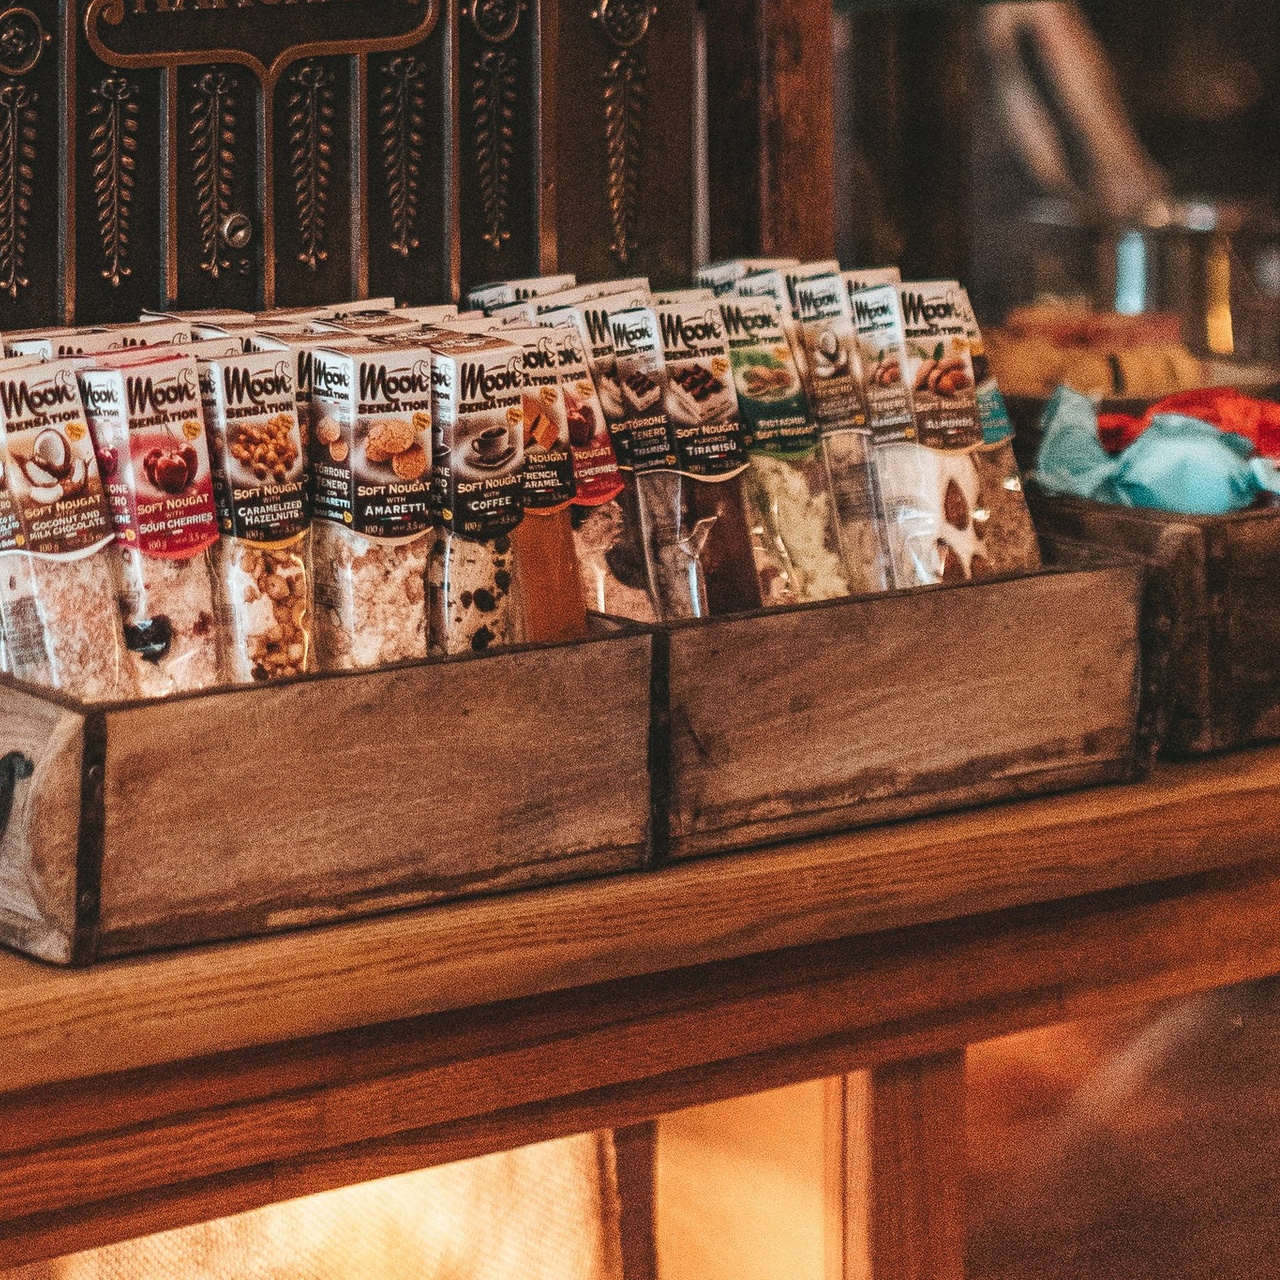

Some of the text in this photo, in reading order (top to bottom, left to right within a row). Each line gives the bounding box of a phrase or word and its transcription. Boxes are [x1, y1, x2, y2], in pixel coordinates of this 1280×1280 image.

[612, 319, 653, 348] Moon
[659, 311, 722, 348] Moon
[664, 346, 725, 360] SENSATION
[313, 357, 350, 390] Moon
[359, 360, 430, 402] Moon
[460, 361, 522, 401] Moon
[126, 372, 196, 416] Moon
[223, 363, 293, 405] Moon
[0, 376, 77, 420] Moon
[357, 399, 429, 415] SENSATION
[459, 395, 522, 414] SENSATION
[128, 409, 198, 430] SENSATION
[226, 402, 294, 419] SENSATION
[6, 410, 80, 434] SENSATION
[675, 422, 740, 439] SOFT NOUGAT
[529, 451, 568, 464] NOUGAT
[233, 481, 303, 500] SOFT NOUGAT
[357, 481, 432, 497] SOFT NOUGAT
[457, 474, 523, 494] SOFT NOUGAT
[524, 478, 563, 489] ARAMEL
[24, 493, 102, 519] SOFT NOUGAT
[137, 493, 209, 515] SOFT NOUGAT
[237, 500, 302, 517] CARAMELIZED
[364, 502, 426, 517] AMARETTI
[386, 496, 406, 504] WITH
[471, 496, 512, 511] COFFEE
[32, 509, 100, 531] COCONUT AND
[52, 516, 106, 536] CHOCOLATE
[139, 511, 213, 534] SOUR CHERRIES
[245, 509, 299, 526] HAZELNUTS
